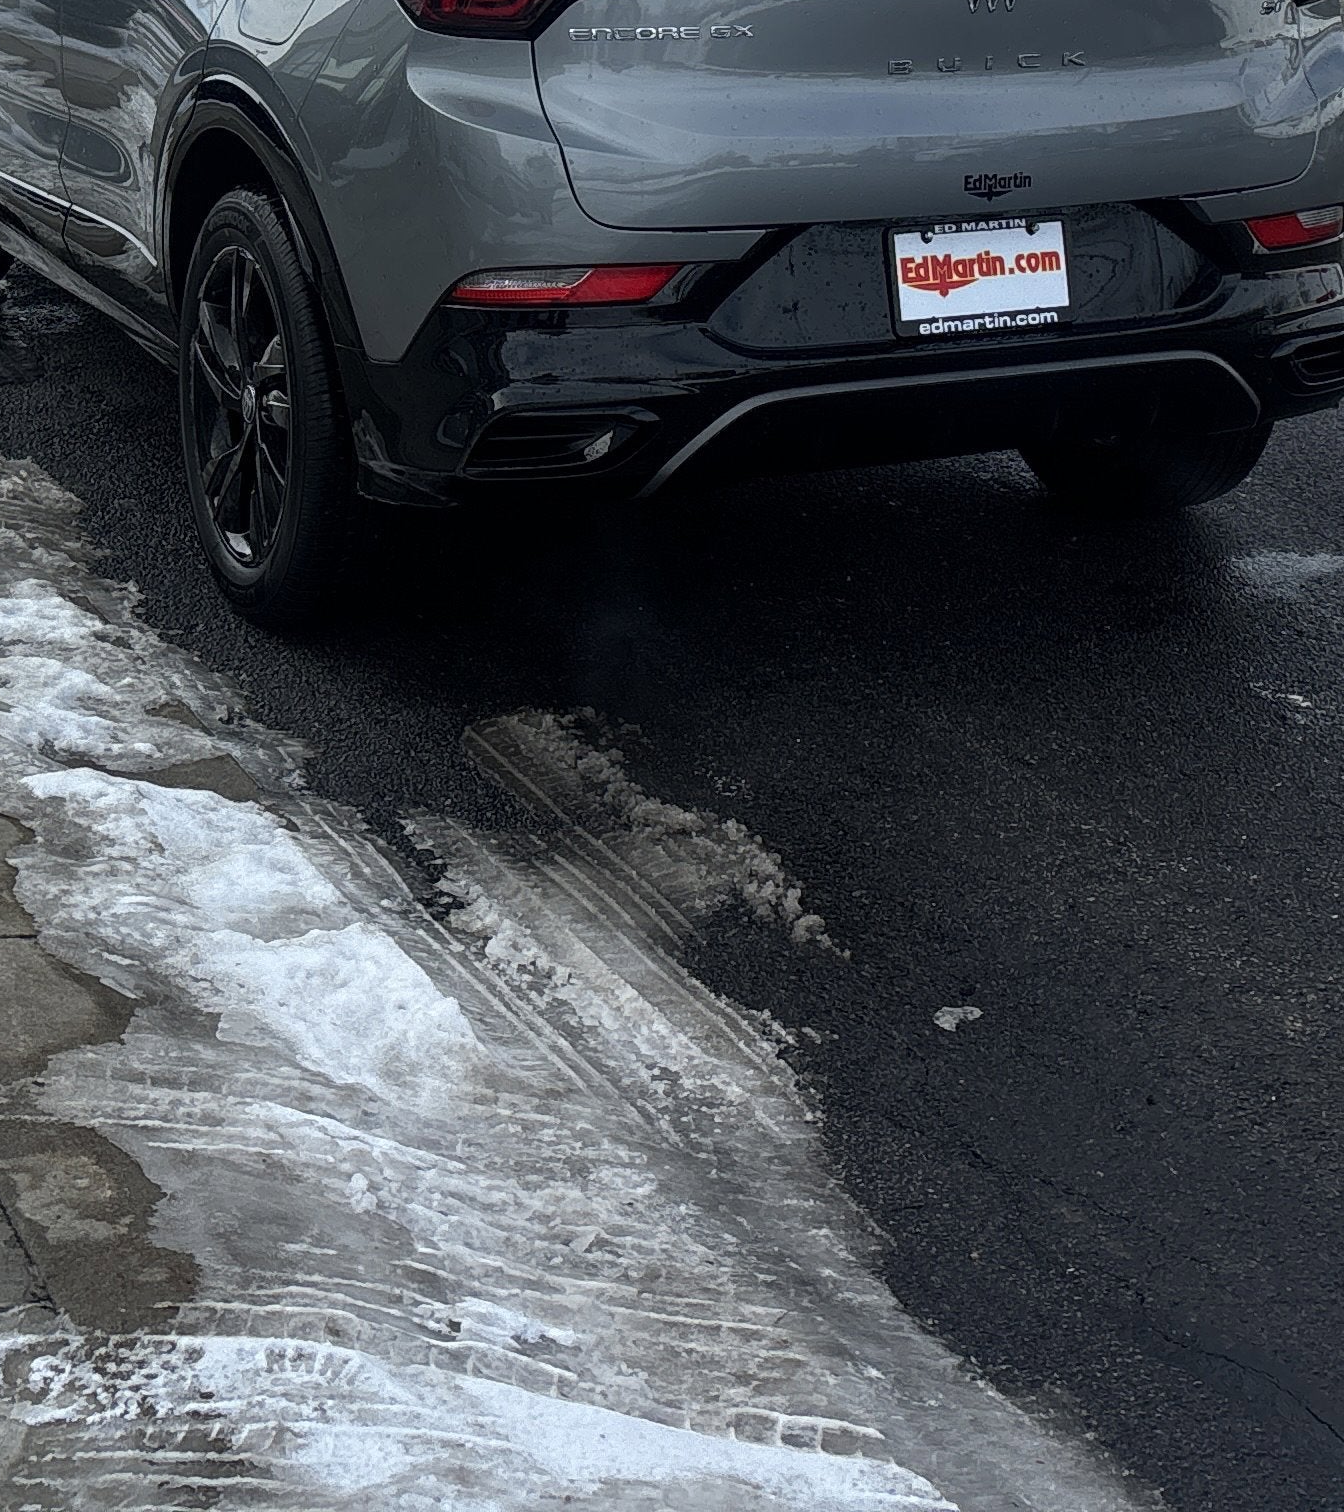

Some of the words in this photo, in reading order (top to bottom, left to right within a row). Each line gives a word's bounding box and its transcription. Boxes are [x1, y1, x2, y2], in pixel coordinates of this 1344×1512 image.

[1259, 0, 1285, 16] ST
[568, 25, 701, 42] ENCORE
[709, 23, 754, 39] GX
[887, 51, 1086, 75] BUICK
[963, 171, 1032, 192] EdMartin
[934, 223, 957, 235] ED
[961, 218, 1027, 231] MARTIN
[919, 311, 1059, 336] edmartin.com
